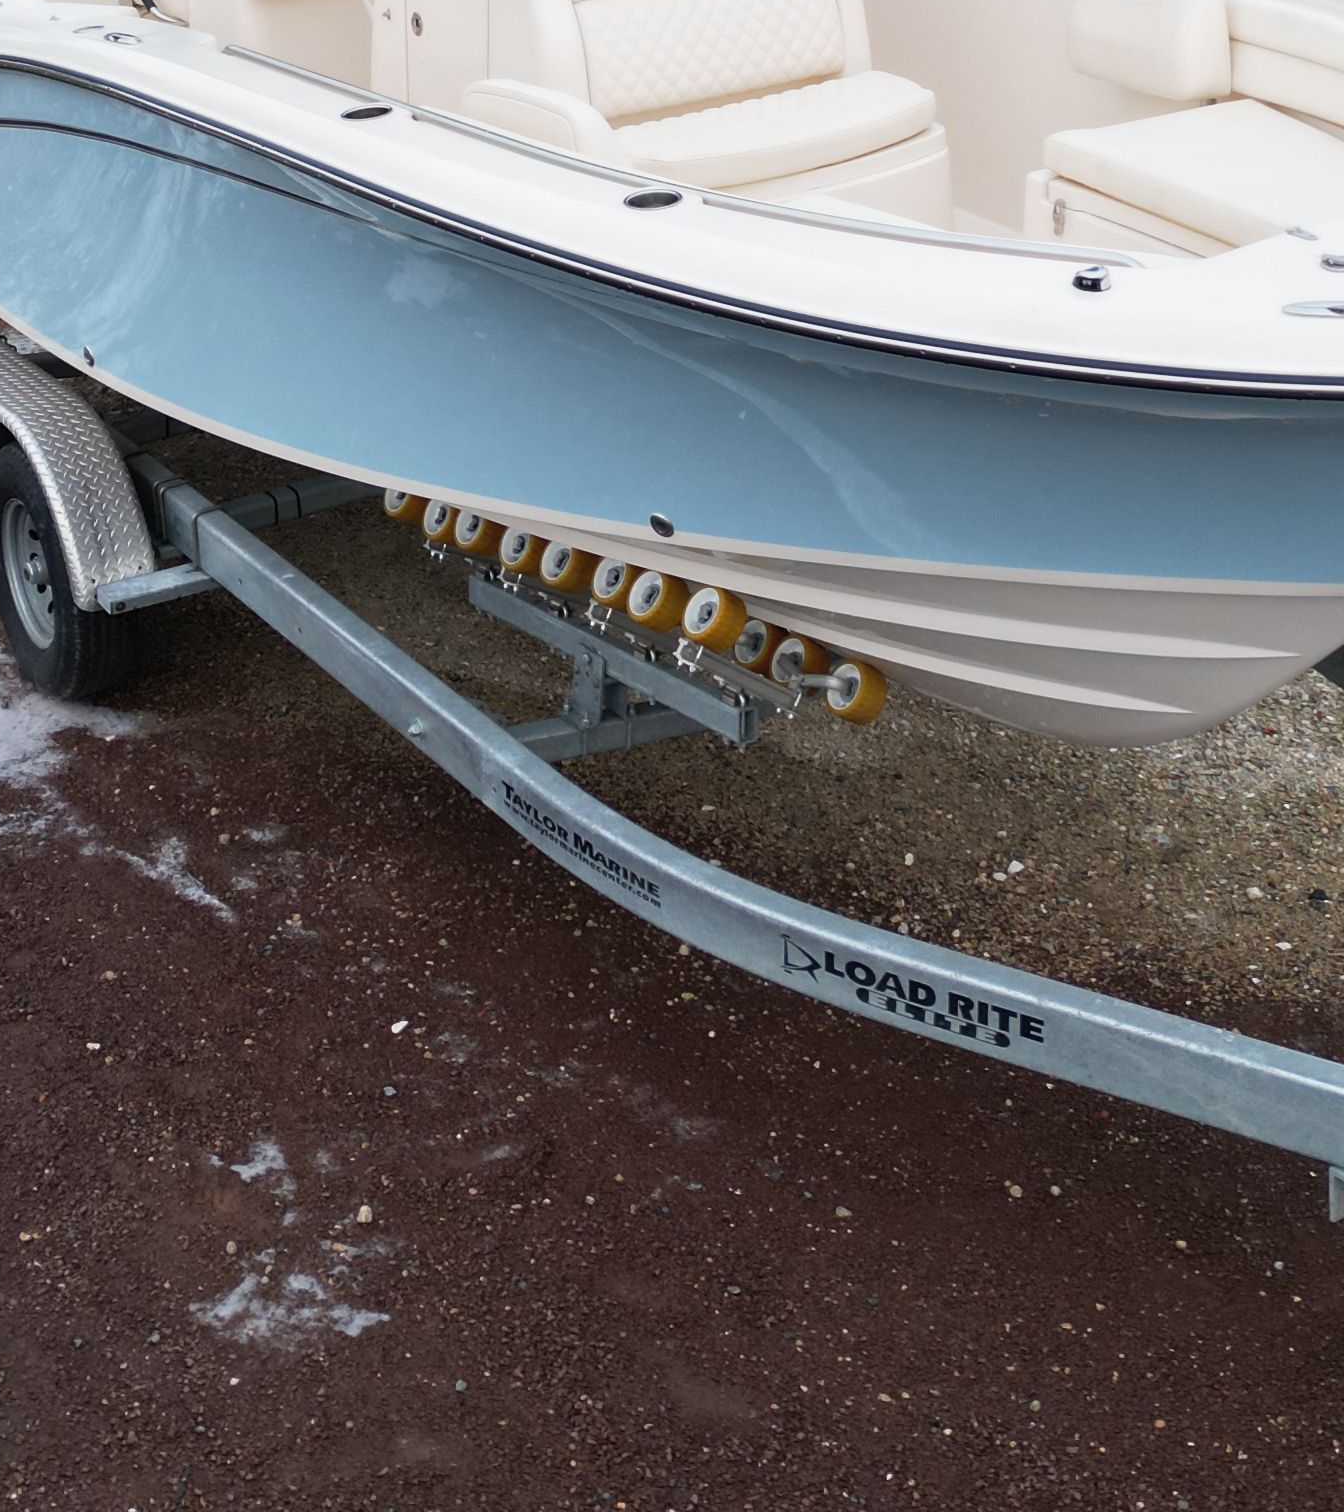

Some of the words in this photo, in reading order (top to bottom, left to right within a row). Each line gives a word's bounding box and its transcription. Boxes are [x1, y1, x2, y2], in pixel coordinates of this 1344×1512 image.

[501, 780, 568, 842] TAYLOR
[573, 832, 660, 899] MARINE
[503, 799, 661, 908] www.taylormarinecenter.com
[824, 951, 936, 1007] LOAD
[948, 991, 1045, 1044] RITE
[856, 987, 1010, 1048] ELITE
